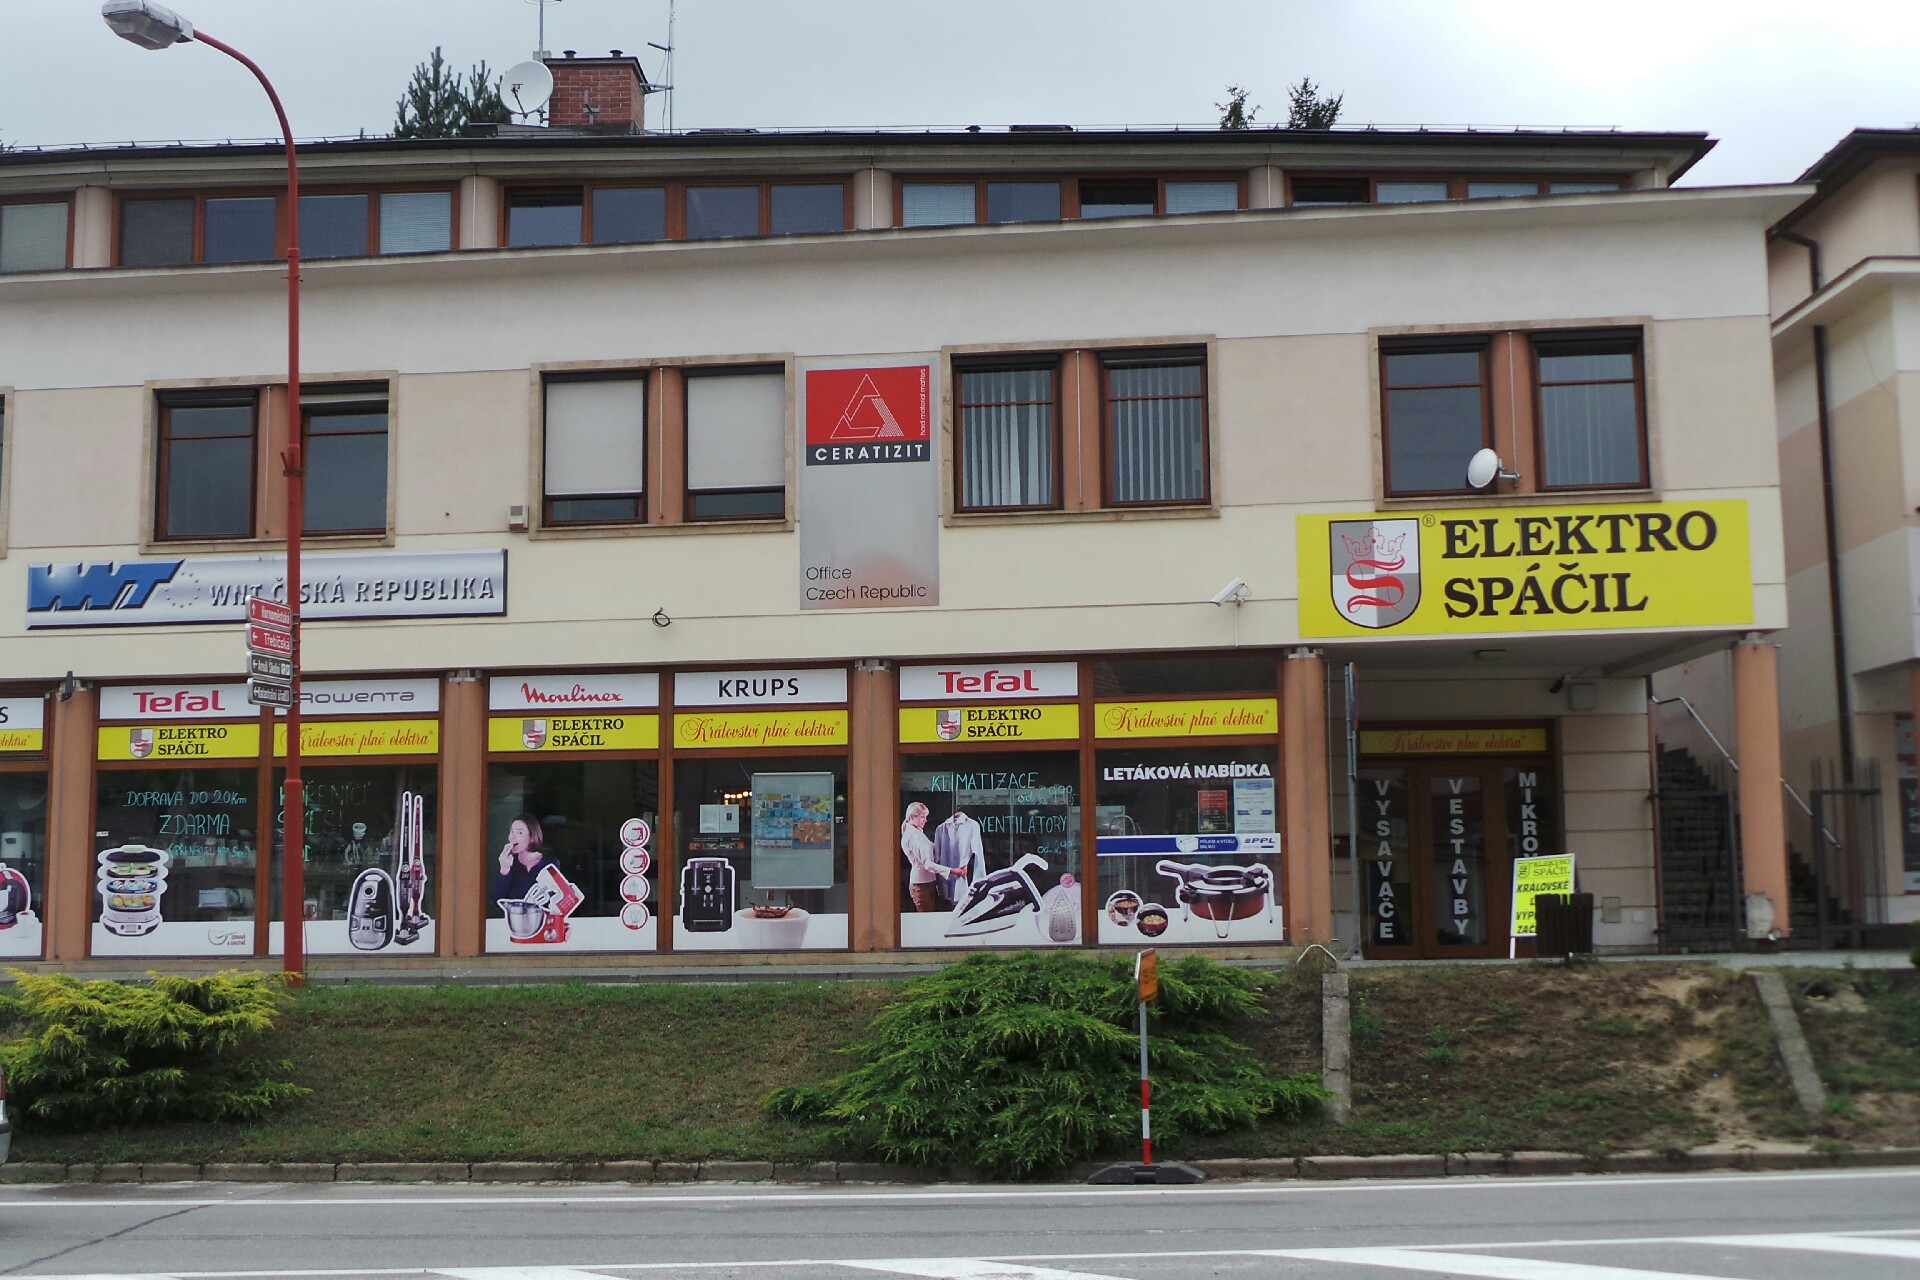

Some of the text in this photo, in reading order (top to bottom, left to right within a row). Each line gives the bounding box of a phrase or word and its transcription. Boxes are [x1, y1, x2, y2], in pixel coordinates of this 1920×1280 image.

[815, 444, 923, 460] CERATIZIT
[1441, 510, 1717, 559] ELEKTRO
[806, 566, 852, 580] Office
[209, 576, 495, 607] WNT ČSKÁ REPUBLIKA
[806, 584, 926, 601] Czech Republic
[1444, 562, 1649, 618] SPÁČIL
[718, 678, 799, 697] KRUPS
[938, 670, 1039, 693] Tefal
[133, 690, 226, 713] Tefal
[521, 683, 623, 703] Moulinex
[552, 718, 624, 731] ELEKTRO
[967, 708, 1042, 721] ELEKTRO
[1103, 706, 1186, 732] Království
[1189, 709, 1217, 734] plné
[158, 727, 228, 740] ELEKTRO
[552, 732, 605, 747] SPÁČIL
[680, 717, 760, 742] Království
[762, 720, 790, 744] plné
[967, 723, 1023, 737] SPÁČIL
[158, 740, 209, 755] SPÁČIL
[358, 730, 385, 753] plné
[1103, 761, 1271, 781] LETÁKOVÁ NABÍDKA
[931, 772, 1039, 793] KLIMATIZACE
[123, 790, 183, 807] DOPRAVA
[189, 791, 208, 804] DO
[159, 813, 230, 835] ZDARMA
[1519, 772, 1539, 857] MIKRO
[1375, 779, 1394, 939] VYSAVAČE
[1448, 778, 1470, 936] VESTAVBY
[1516, 909, 1535, 920] VÝP
[1517, 922, 1536, 934] ZAČ
